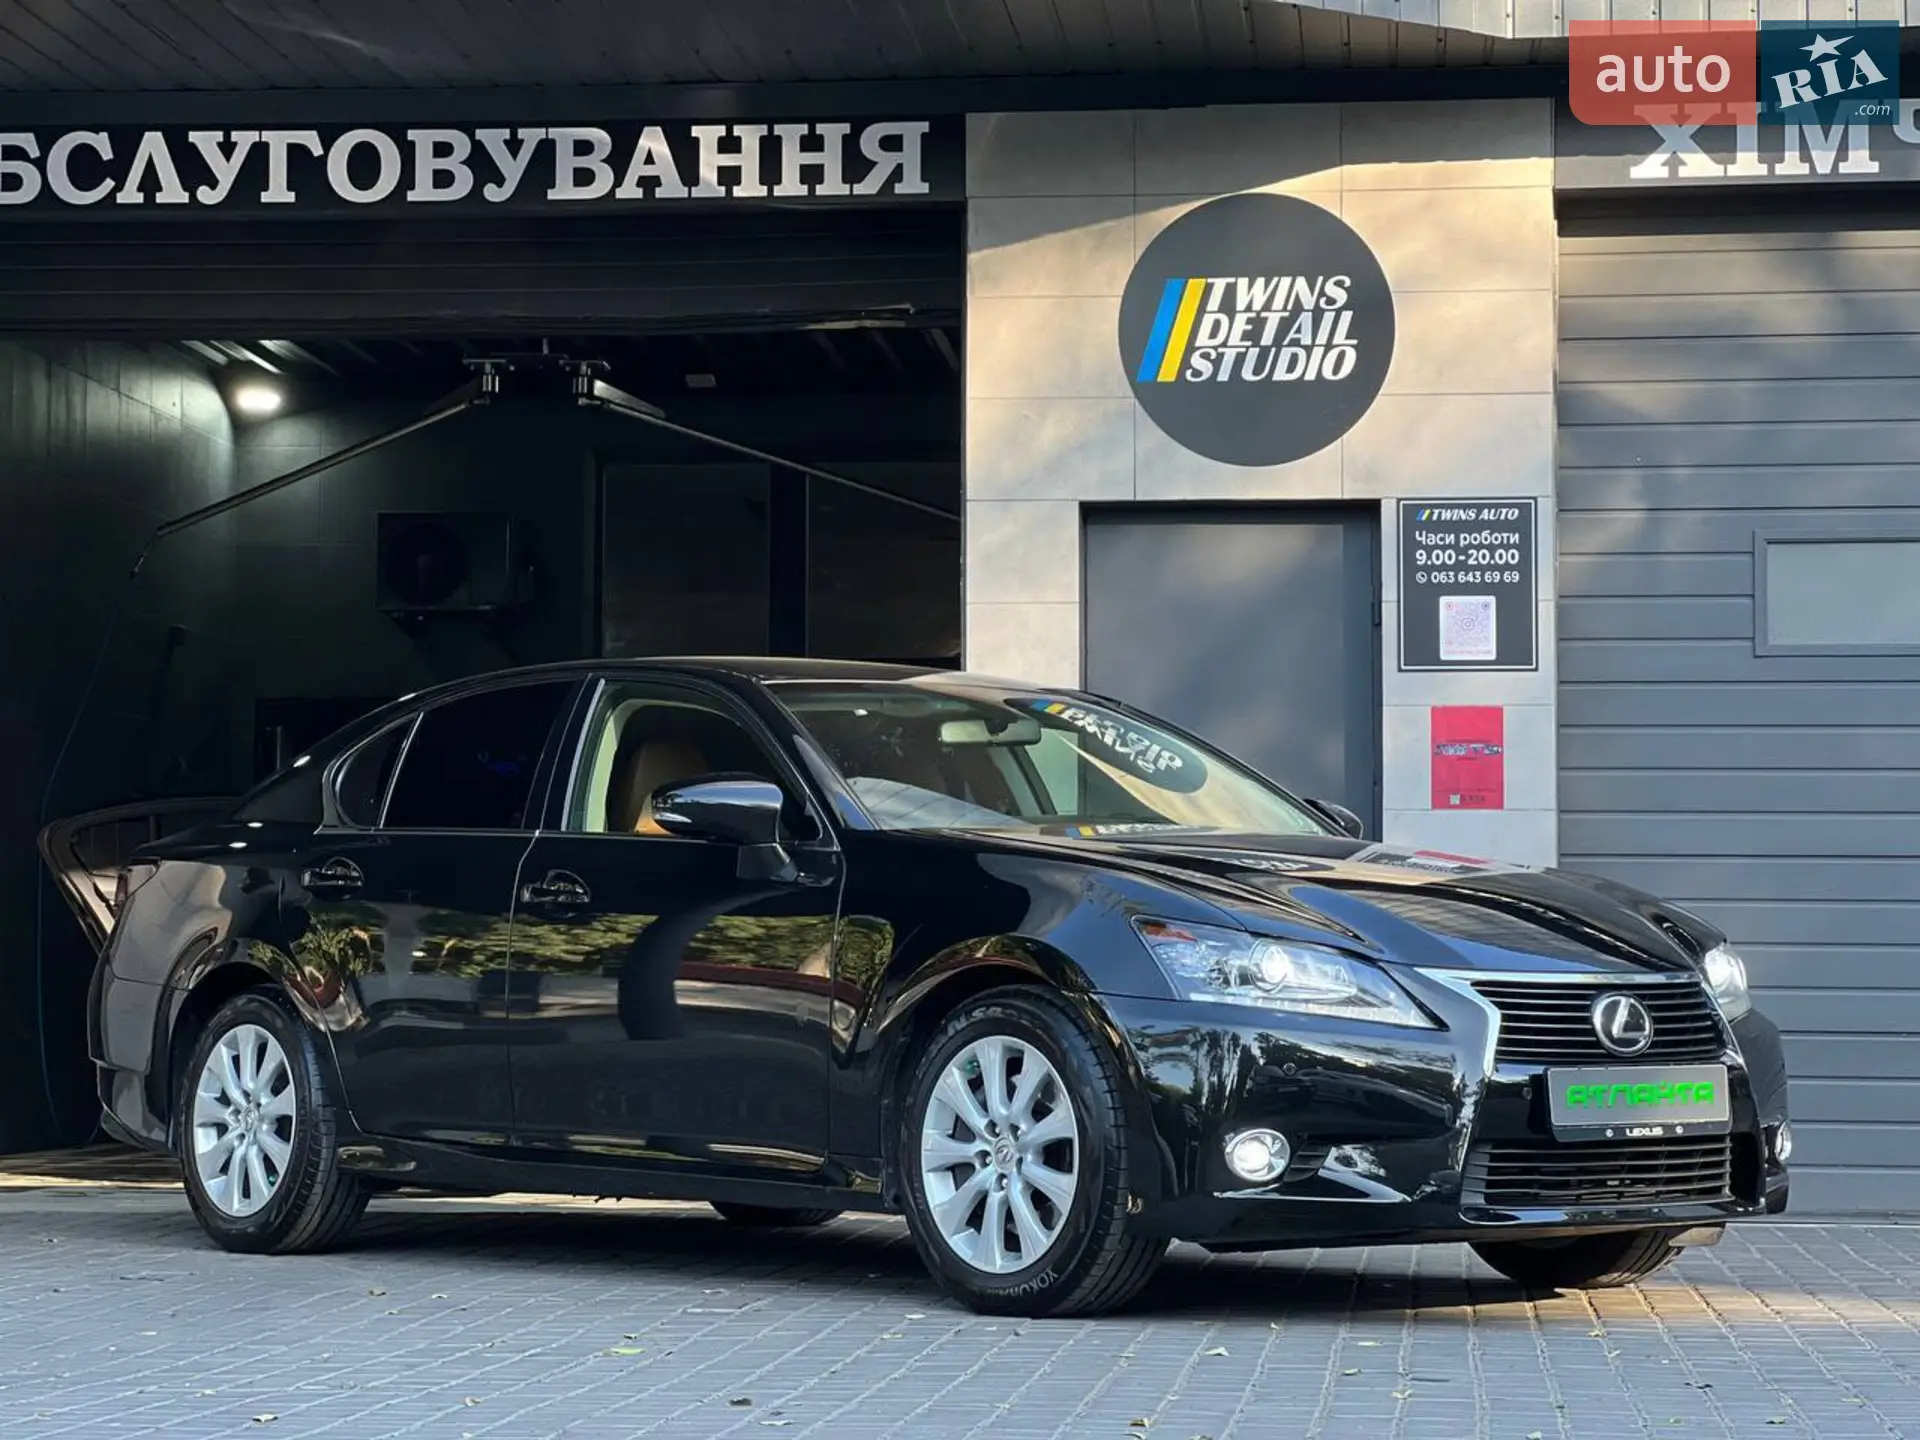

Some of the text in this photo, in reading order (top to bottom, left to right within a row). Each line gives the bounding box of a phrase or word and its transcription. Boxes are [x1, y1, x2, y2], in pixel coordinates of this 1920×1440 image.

[1205, 275, 1351, 312] TWINS
[1195, 310, 1358, 347] DETAIL
[1185, 345, 1358, 382] STUDIO
[1432, 507, 1519, 521] TWINS AUTO
[1415, 529, 1519, 547] Часи роботи
[1431, 571, 1520, 583] 063 643 69 69
[1625, 1126, 1664, 1137] LEXUS
